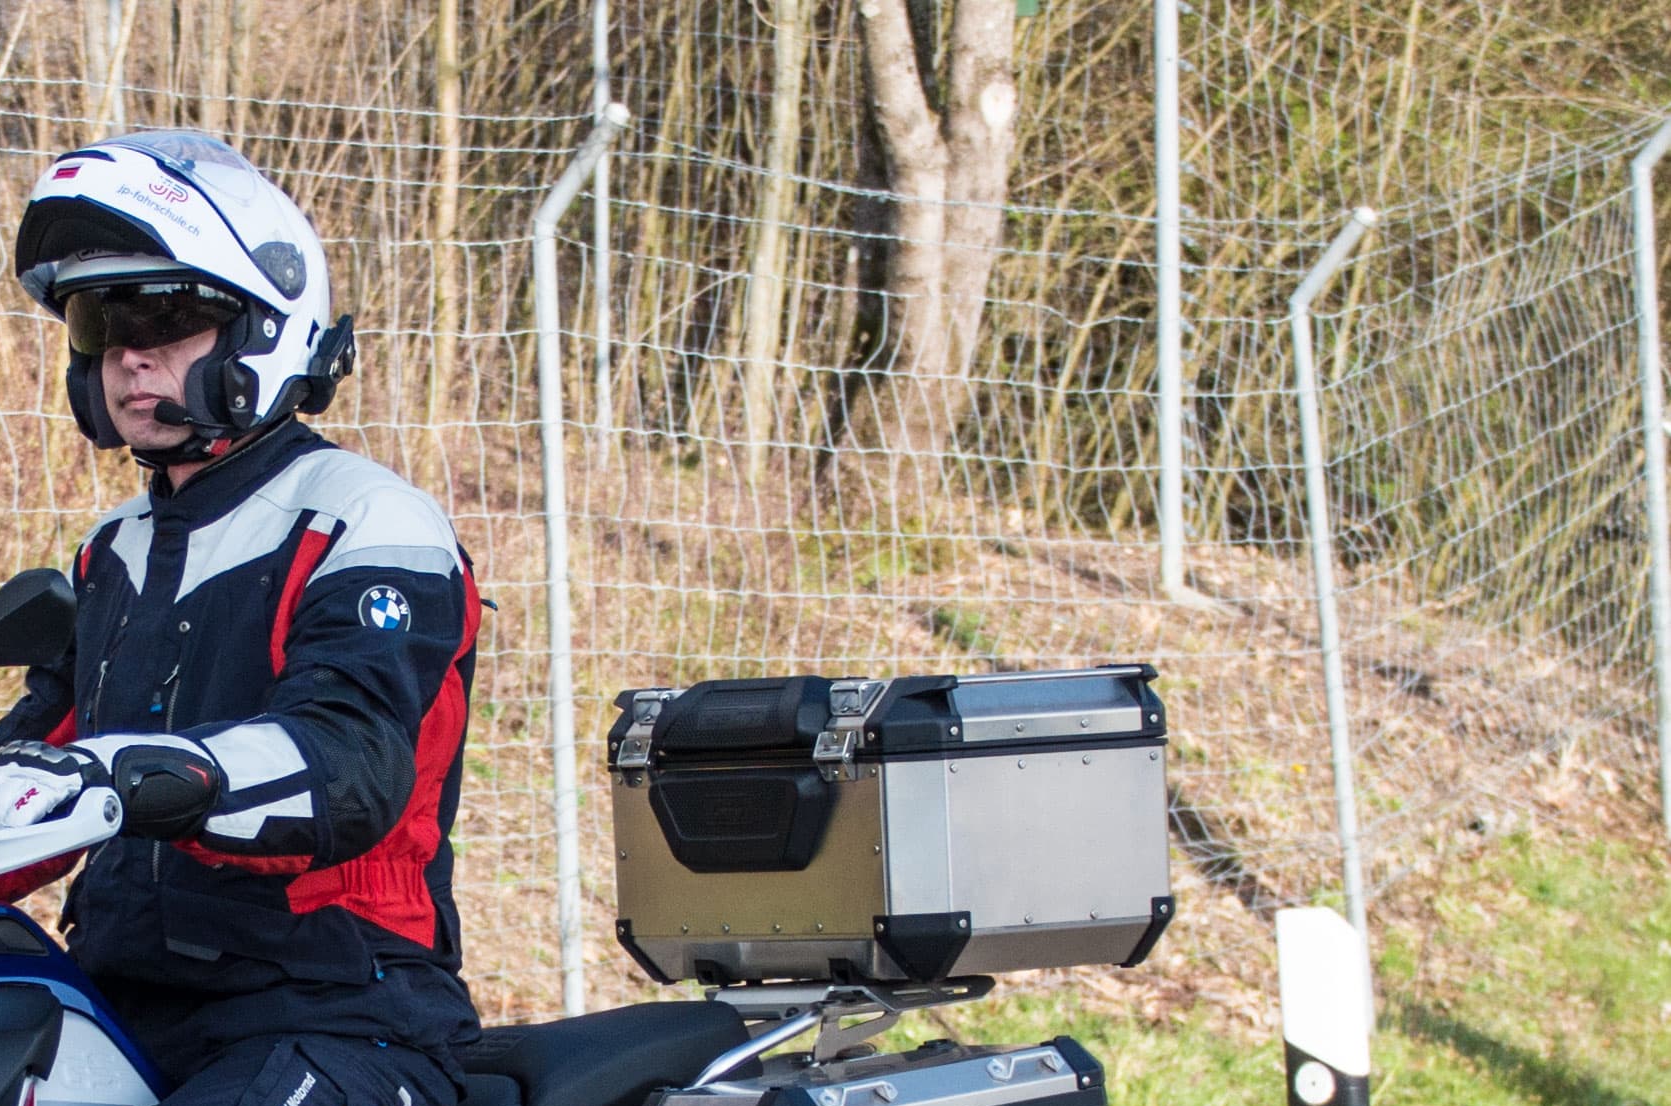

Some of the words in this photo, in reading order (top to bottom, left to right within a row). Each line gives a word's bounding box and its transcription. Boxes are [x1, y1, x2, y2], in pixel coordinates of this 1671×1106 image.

[117, 183, 200, 236] jp-fahrschule.ch
[370, 589, 409, 615] BMW
[14, 787, 40, 811] RR
